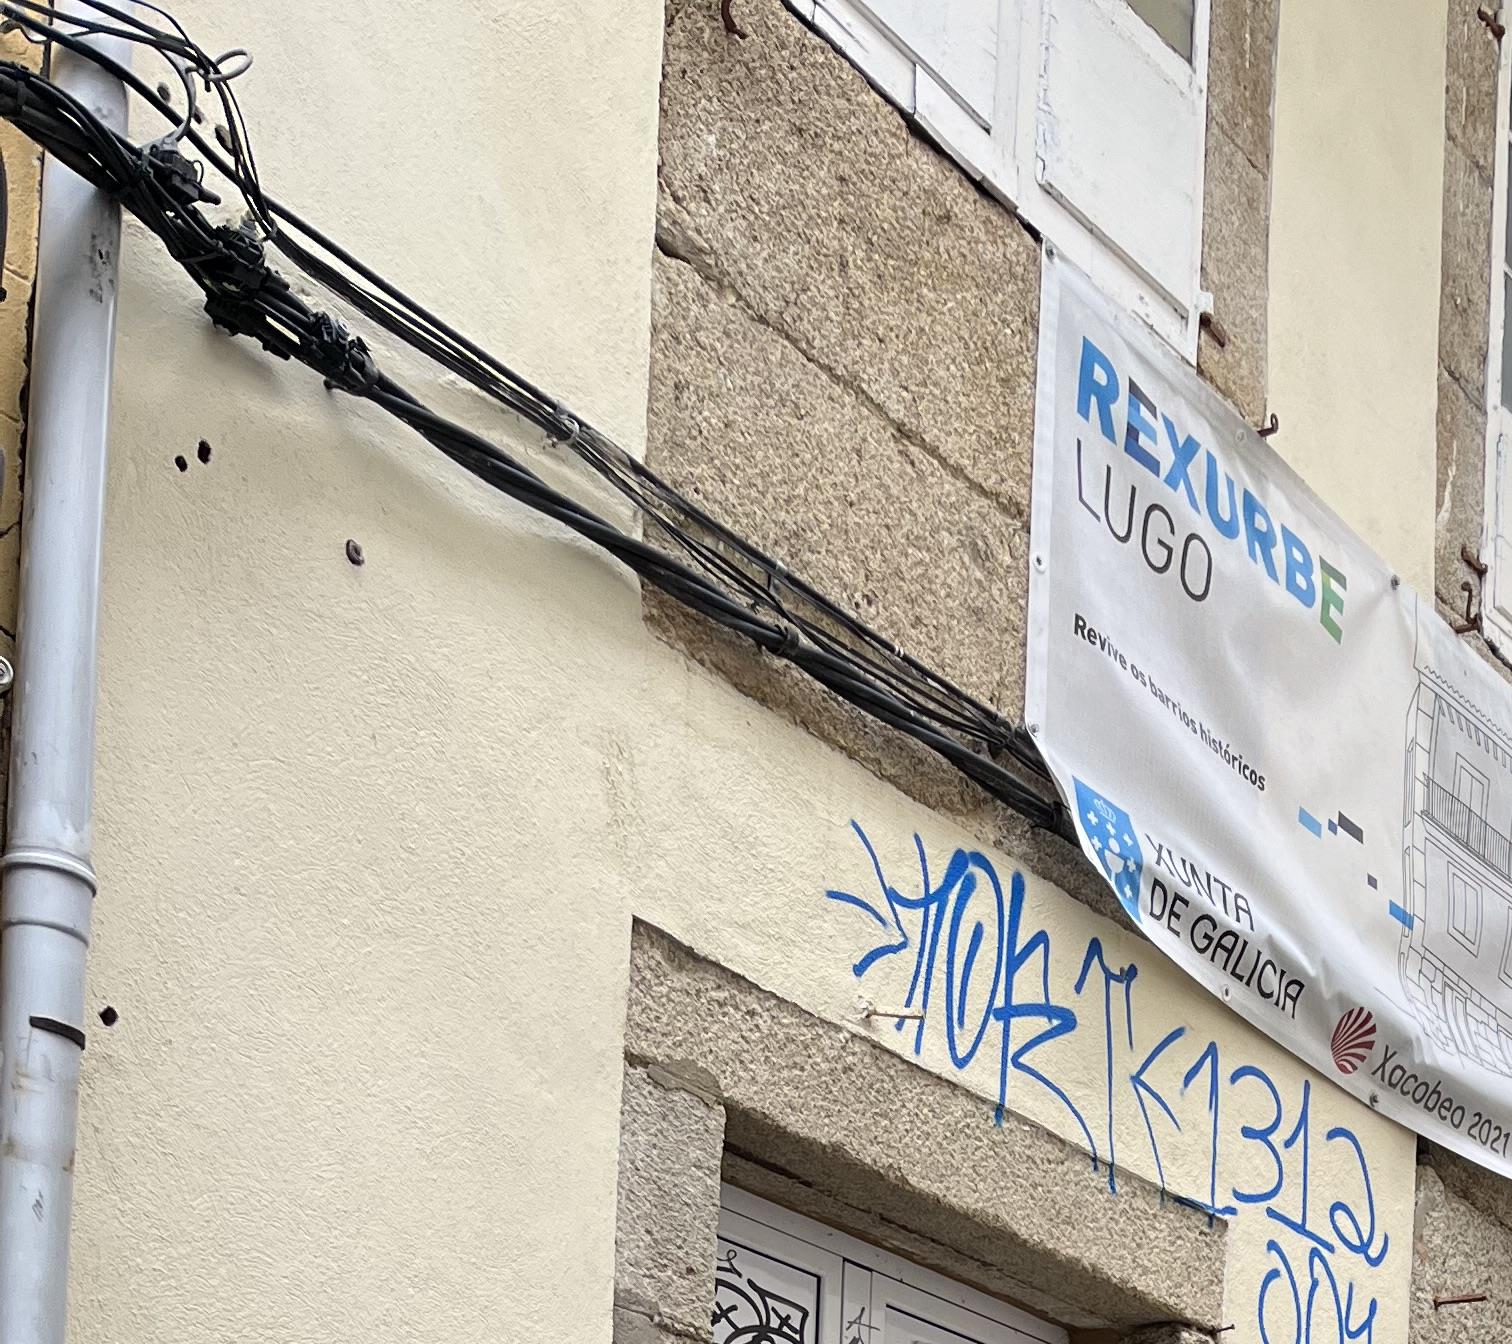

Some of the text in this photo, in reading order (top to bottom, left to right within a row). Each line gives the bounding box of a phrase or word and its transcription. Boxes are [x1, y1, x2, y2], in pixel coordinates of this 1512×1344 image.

[1077, 335, 1347, 644] REXURBE
[1077, 438, 1212, 602] LUGO
[1073, 613, 1267, 793] Revive os barrios históricos
[1144, 832, 1256, 933] XUNTA
[1148, 876, 1306, 1021] DE GALICIA
[1371, 1044, 1511, 1160] Xacobeo 2021
